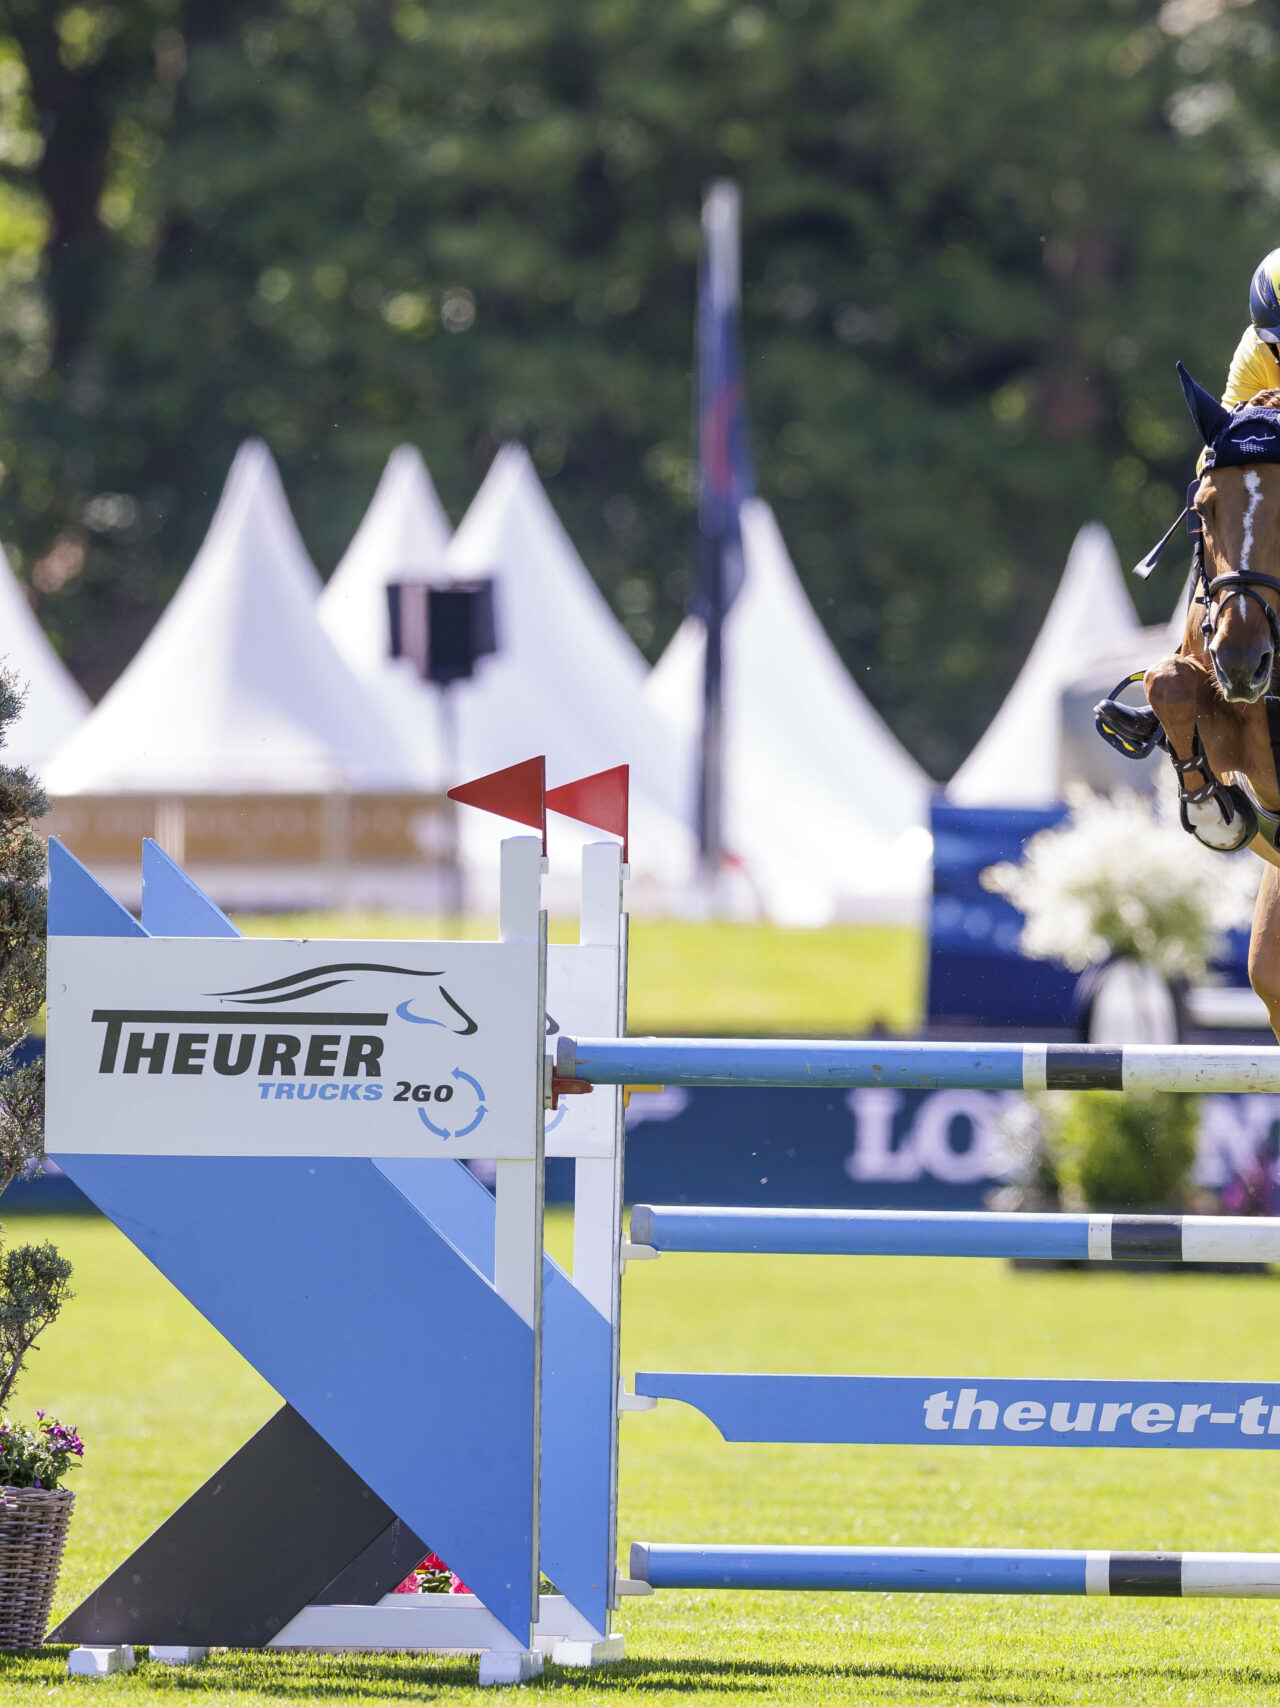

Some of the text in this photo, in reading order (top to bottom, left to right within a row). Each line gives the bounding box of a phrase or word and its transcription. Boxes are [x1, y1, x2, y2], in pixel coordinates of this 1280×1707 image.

[92, 1009, 388, 1077] THEURER
[257, 1081, 454, 1103] TRUCKS 2GO
